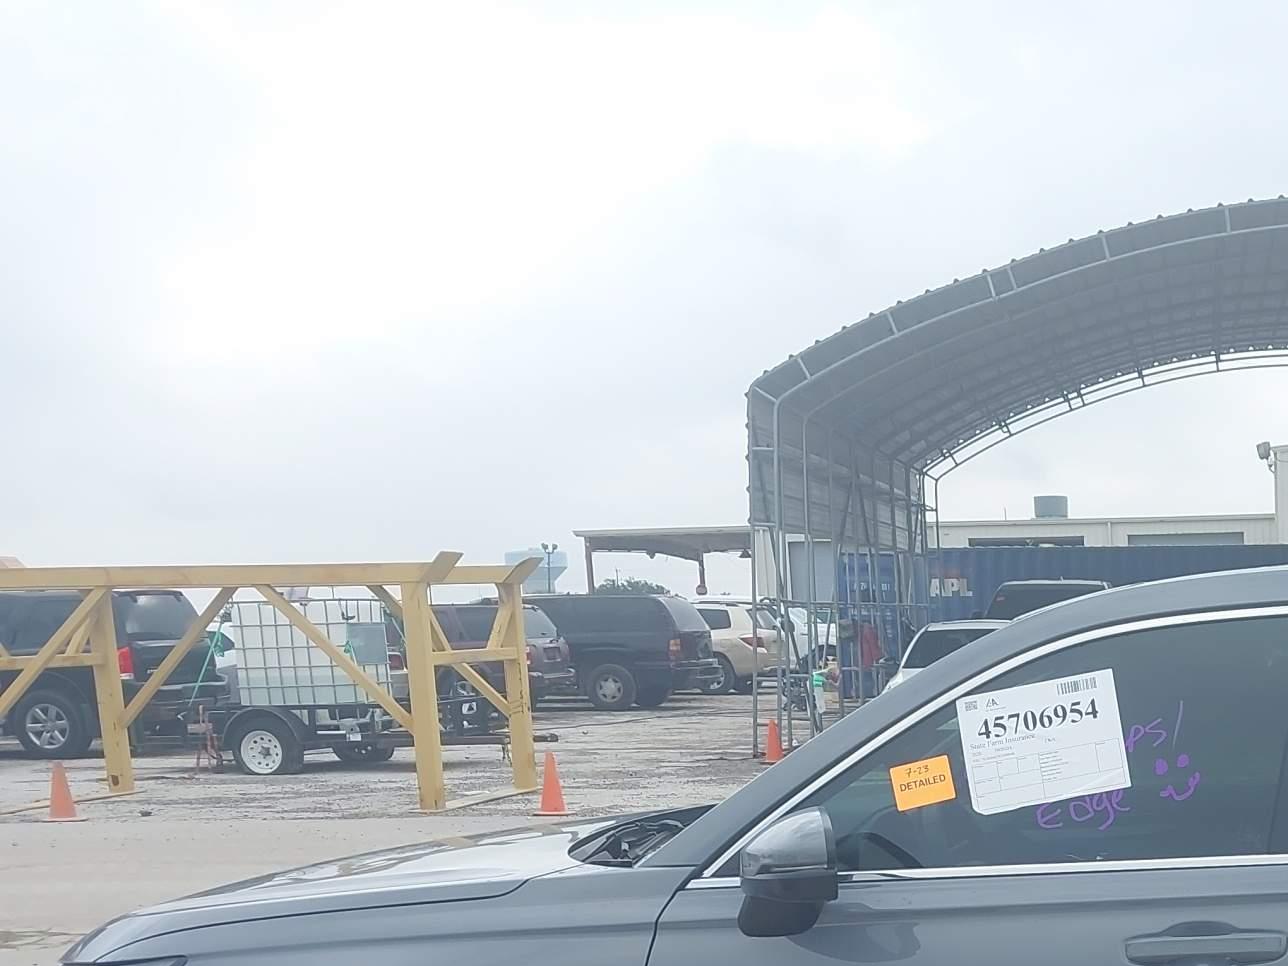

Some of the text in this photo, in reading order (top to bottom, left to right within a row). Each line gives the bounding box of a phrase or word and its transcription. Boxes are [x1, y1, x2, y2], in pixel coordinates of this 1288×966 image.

[930, 578, 973, 597] APL
[977, 697, 1099, 740] 45706954
[904, 764, 929, 778] 7-23
[900, 774, 946, 792] DETAILED
